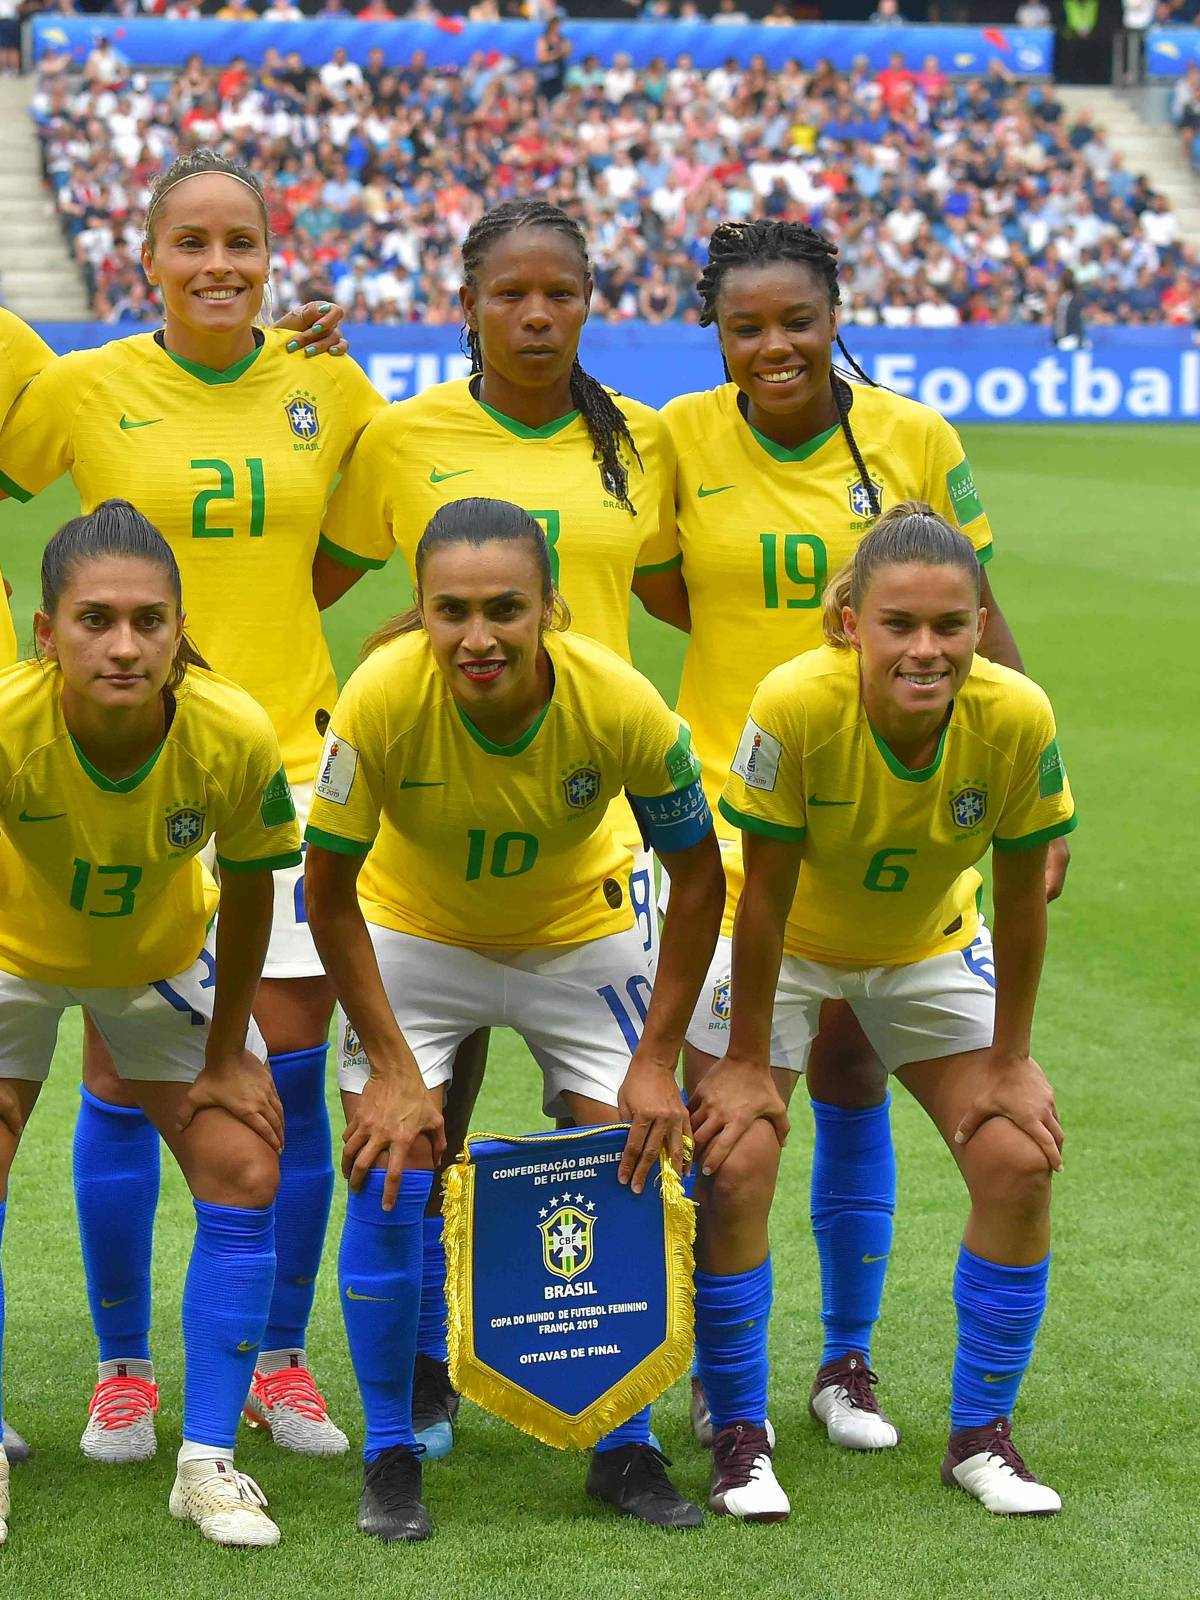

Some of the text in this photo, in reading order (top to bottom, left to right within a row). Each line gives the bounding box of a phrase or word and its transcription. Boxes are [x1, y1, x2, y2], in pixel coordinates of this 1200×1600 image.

[293, 443, 321, 452] BRASIL
[190, 458, 266, 538] 21
[760, 533, 828, 609] 19
[466, 829, 539, 882] 10
[863, 848, 918, 892] 6
[69, 857, 143, 918] 13
[492, 1159, 576, 1180] CONFEDERAÇÃO
[534, 1168, 598, 1186] DE FUTEBOL
[559, 1236, 576, 1246] CBF
[544, 1281, 598, 1300] BRASIL
[490, 1301, 648, 1328] COPA DO MUNDO DE FUTEBOL FEMININO
[538, 1319, 599, 1335] FRANÇA 2019
[519, 1344, 621, 1364] OITAVAS DE FINAL
